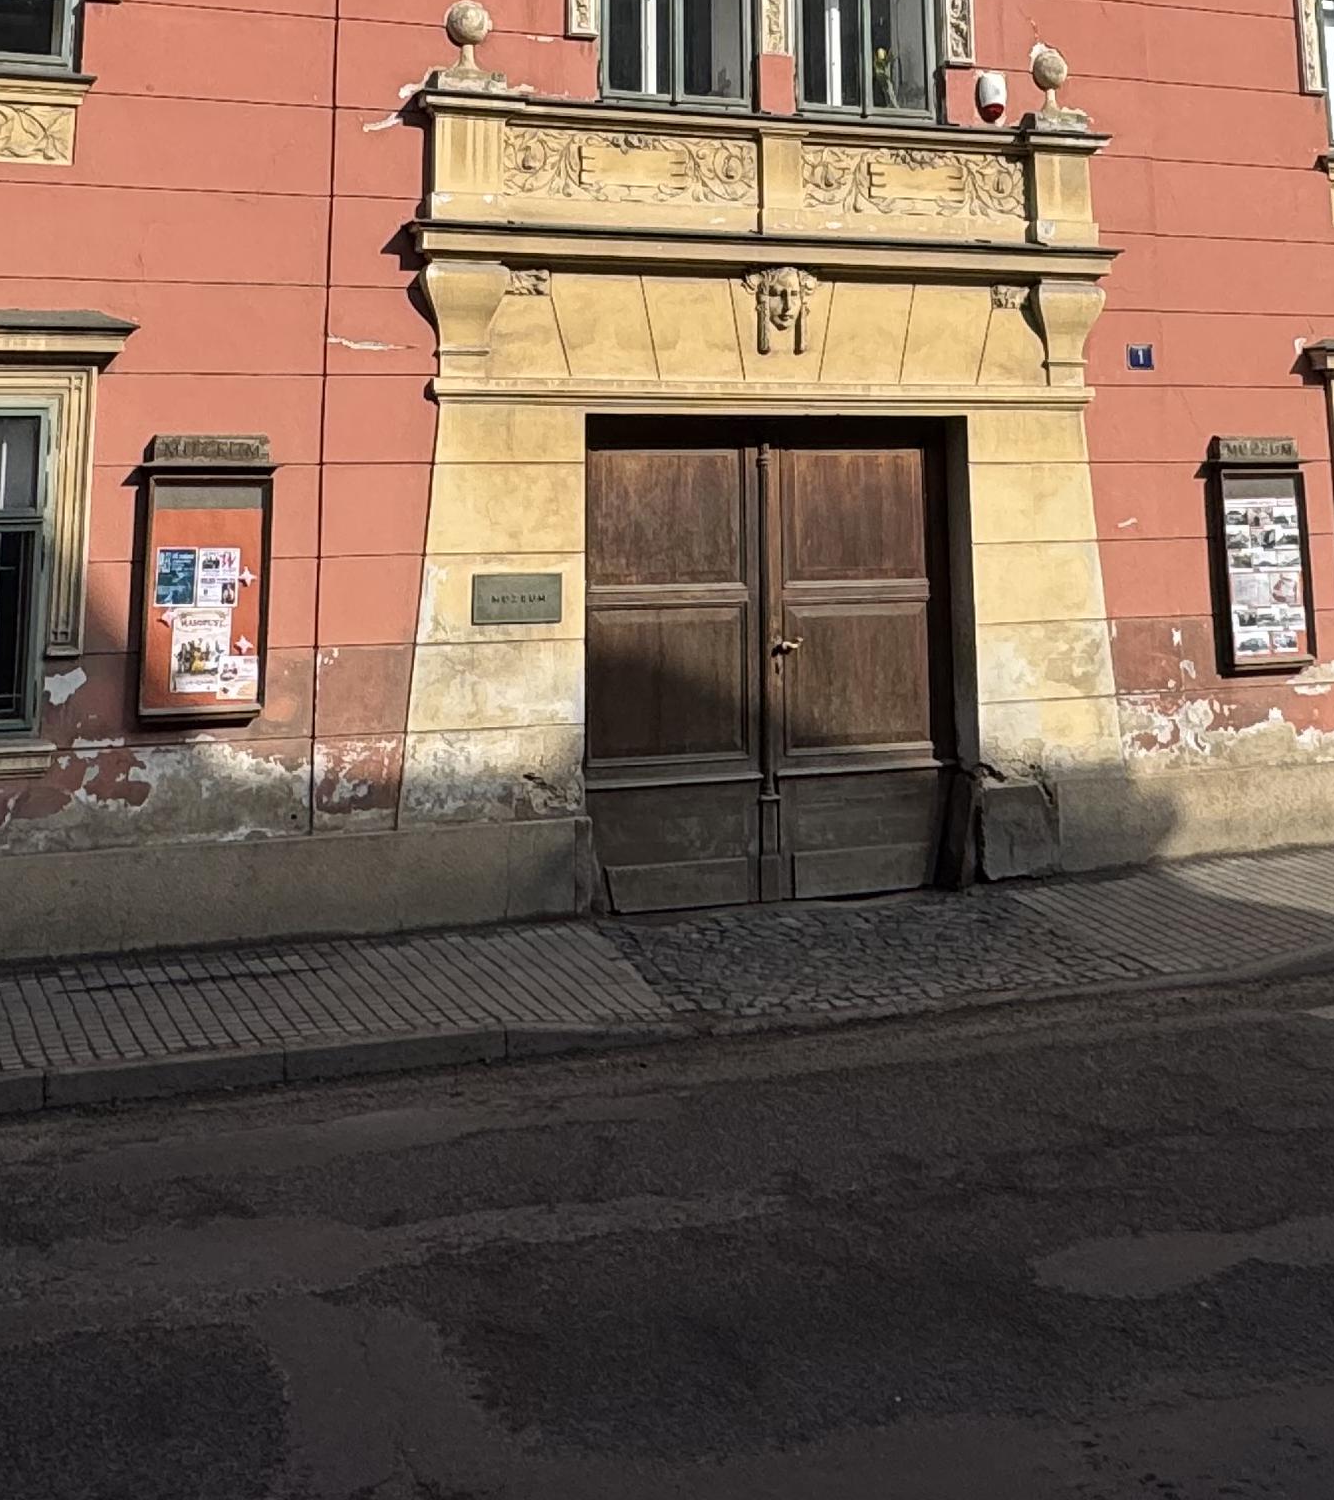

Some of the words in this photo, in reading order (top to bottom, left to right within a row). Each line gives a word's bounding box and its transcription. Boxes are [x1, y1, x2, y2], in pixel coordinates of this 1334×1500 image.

[1137, 348, 1145, 365] 1
[1225, 442, 1292, 457] MUZEUM
[491, 594, 546, 604] MUZEUM
